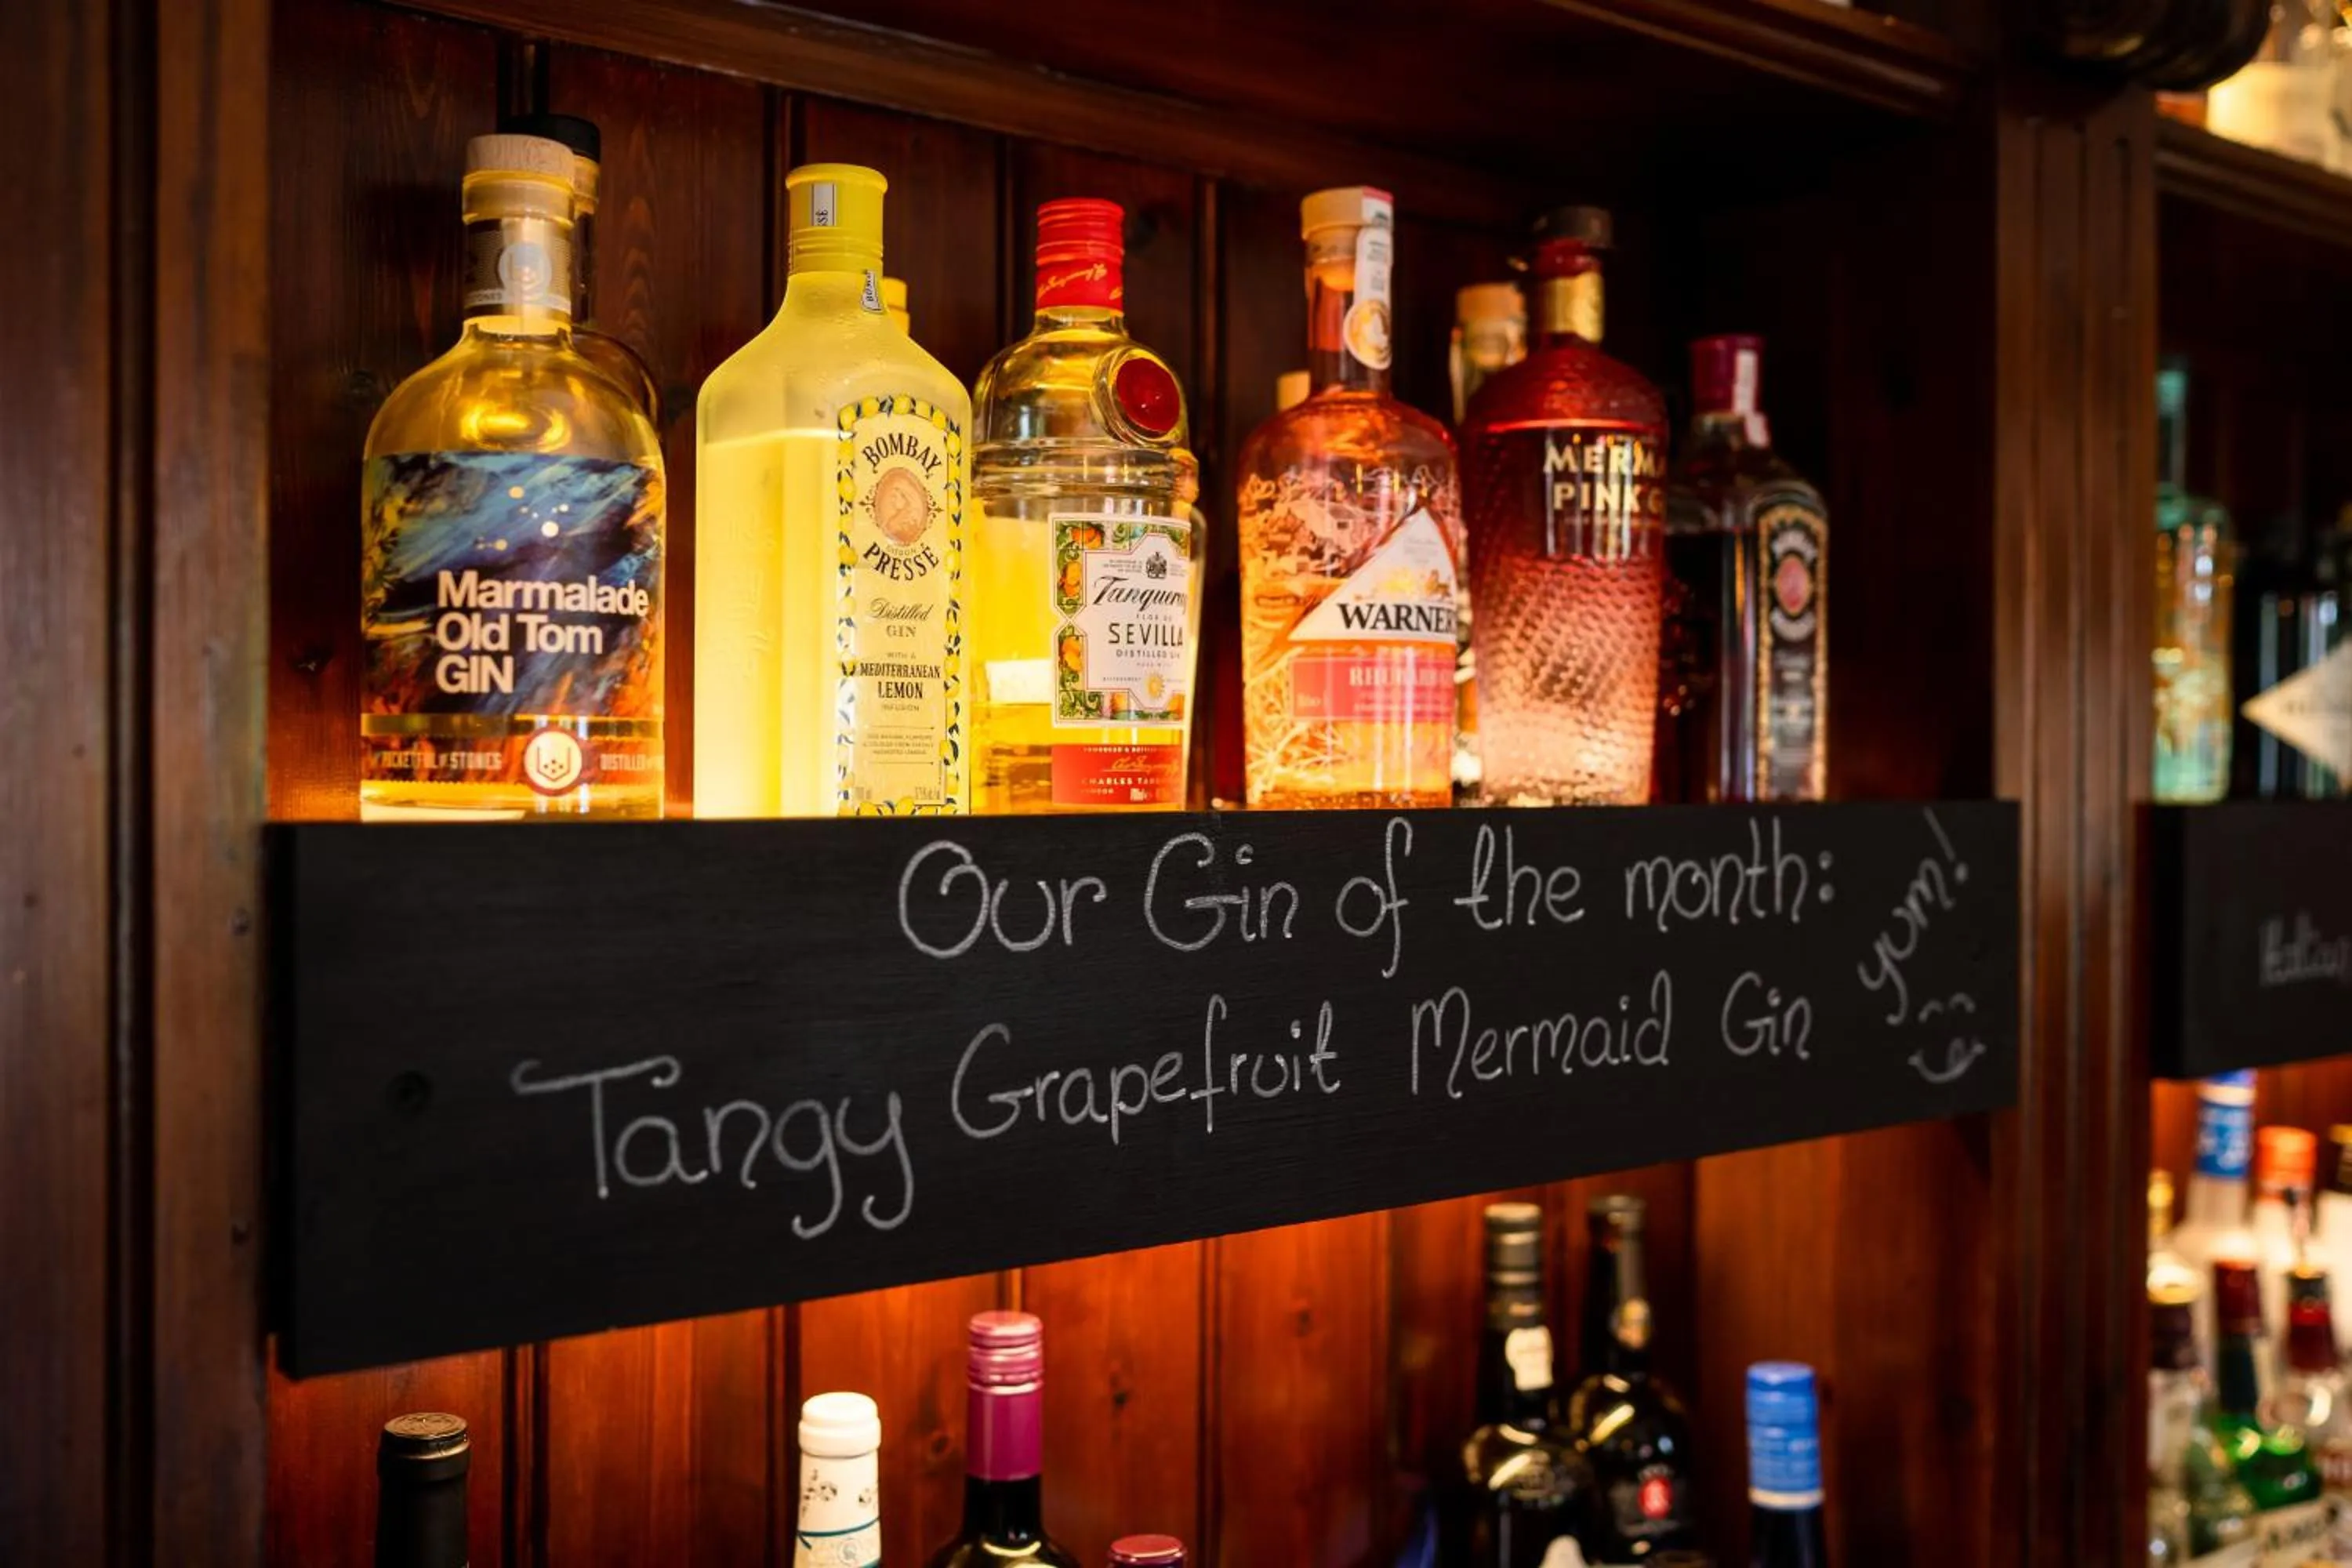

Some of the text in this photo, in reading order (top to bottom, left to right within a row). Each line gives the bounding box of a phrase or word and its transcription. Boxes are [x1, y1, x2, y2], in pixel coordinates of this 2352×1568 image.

[862, 433, 942, 480] BOMBAY
[1553, 481, 1641, 512] PINK
[437, 570, 649, 617] Marmalade
[869, 597, 934, 621] Distilled
[435, 612, 604, 655] Old Tom
[886, 625, 916, 638] GIN
[1108, 622, 1183, 647] SEVILLA
[1116, 649, 1167, 659] DISTILLED
[435, 655, 514, 695] GIN
[859, 663, 941, 679] MEDITERRANEAN
[877, 681, 924, 699] LEMON
[898, 816, 1833, 978] Our Gin of the month:
[511, 970, 1812, 1239] Tangy Grapefruit Mermaid Gin
